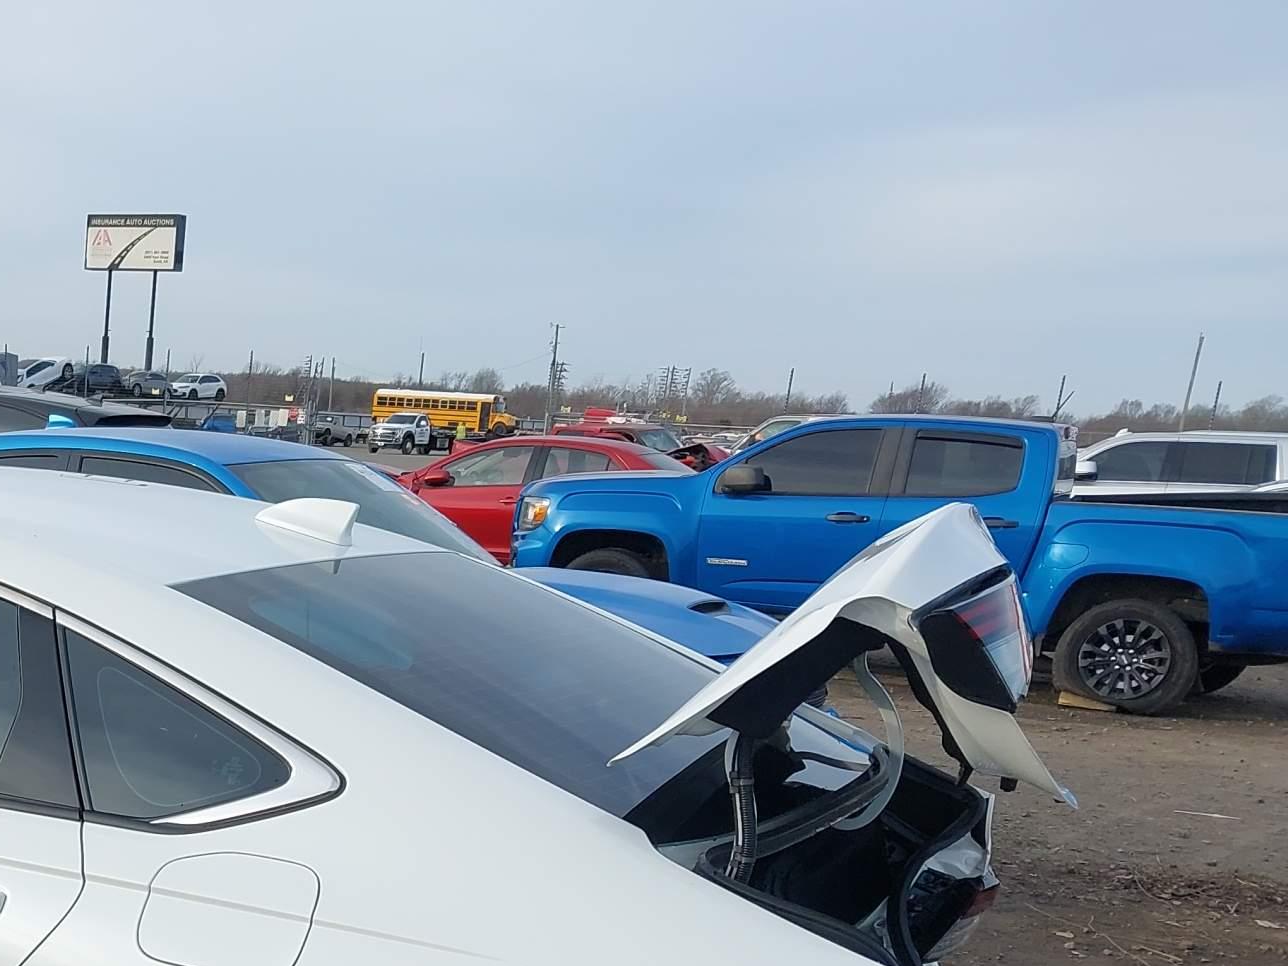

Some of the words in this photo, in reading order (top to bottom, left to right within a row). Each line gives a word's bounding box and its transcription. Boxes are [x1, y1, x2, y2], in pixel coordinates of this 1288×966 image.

[91, 218, 125, 226] INSURANCE
[126, 218, 143, 226] AUTO
[143, 218, 175, 226] AUCTIONS
